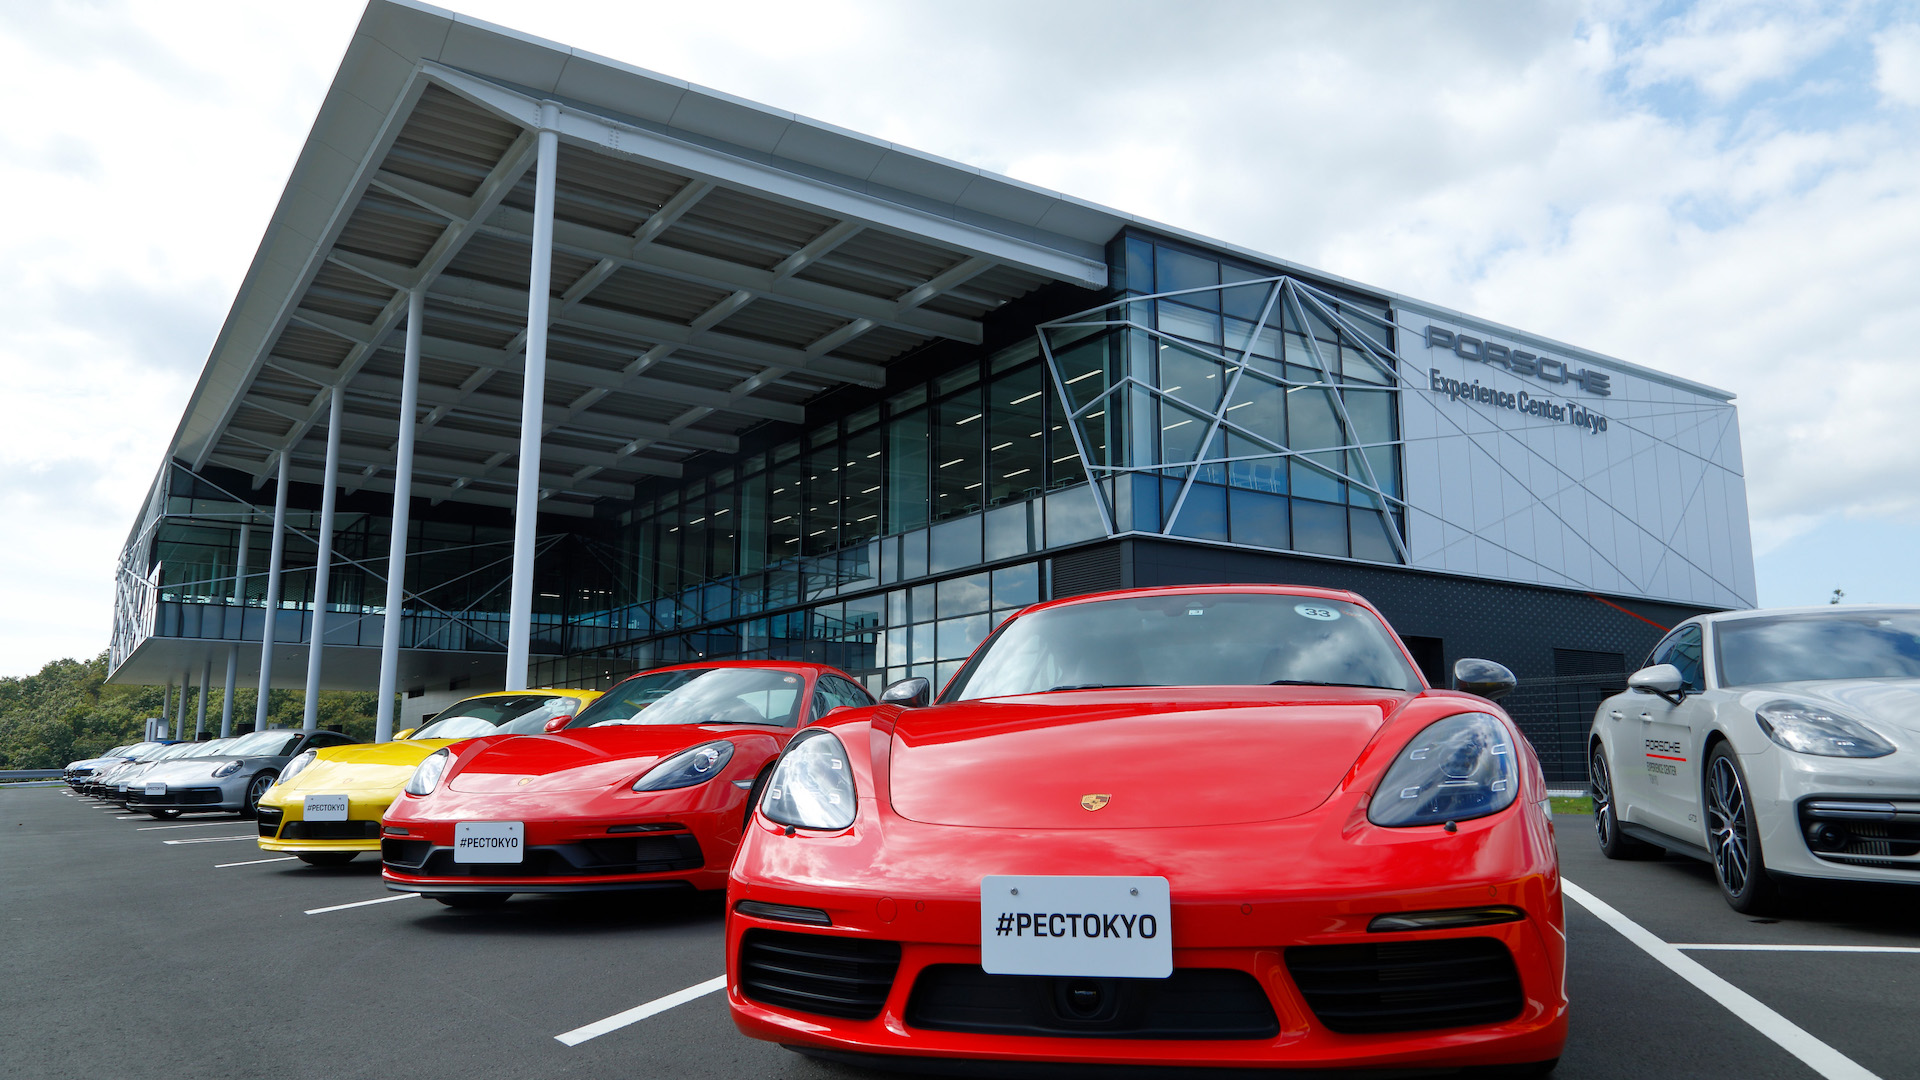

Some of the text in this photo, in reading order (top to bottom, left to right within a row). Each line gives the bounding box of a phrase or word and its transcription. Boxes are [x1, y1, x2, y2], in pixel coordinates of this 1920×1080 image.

[1425, 325, 1611, 396] PORSCHE
[1429, 368, 1608, 435] Experience Center Tokyo
[1305, 608, 1330, 617] 33
[1645, 739, 1680, 753] PORSCHE
[307, 803, 345, 812] #PECTOKYO
[459, 837, 519, 848] #PECTOKYO
[995, 912, 1158, 939] #PECTOKYO
